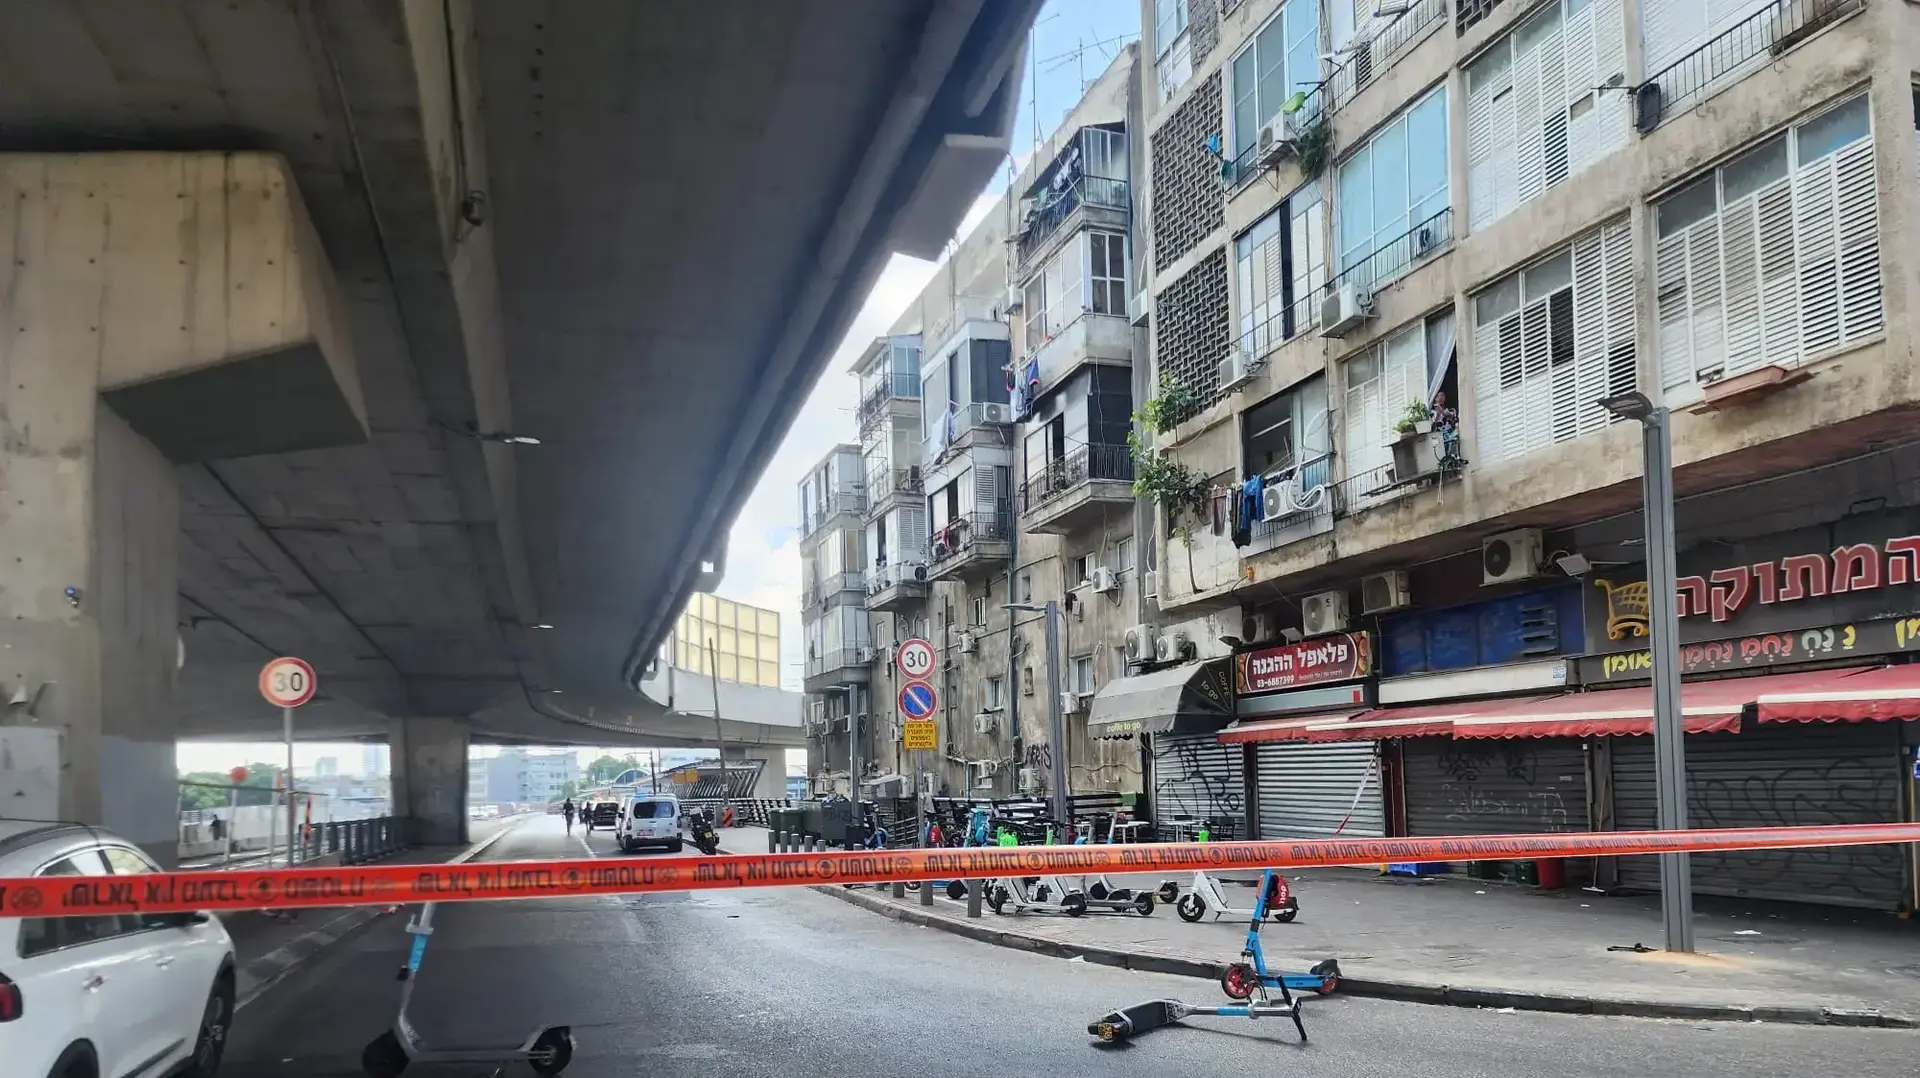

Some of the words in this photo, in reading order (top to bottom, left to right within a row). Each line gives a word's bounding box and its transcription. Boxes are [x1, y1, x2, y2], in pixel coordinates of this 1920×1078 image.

[905, 651, 928, 668] 30
[1252, 654, 1293, 675] ההגנה
[1297, 642, 1348, 668] פלאפל
[274, 671, 303, 692] 30
[1208, 689, 1219, 700] go
[1131, 721, 1141, 732] go
